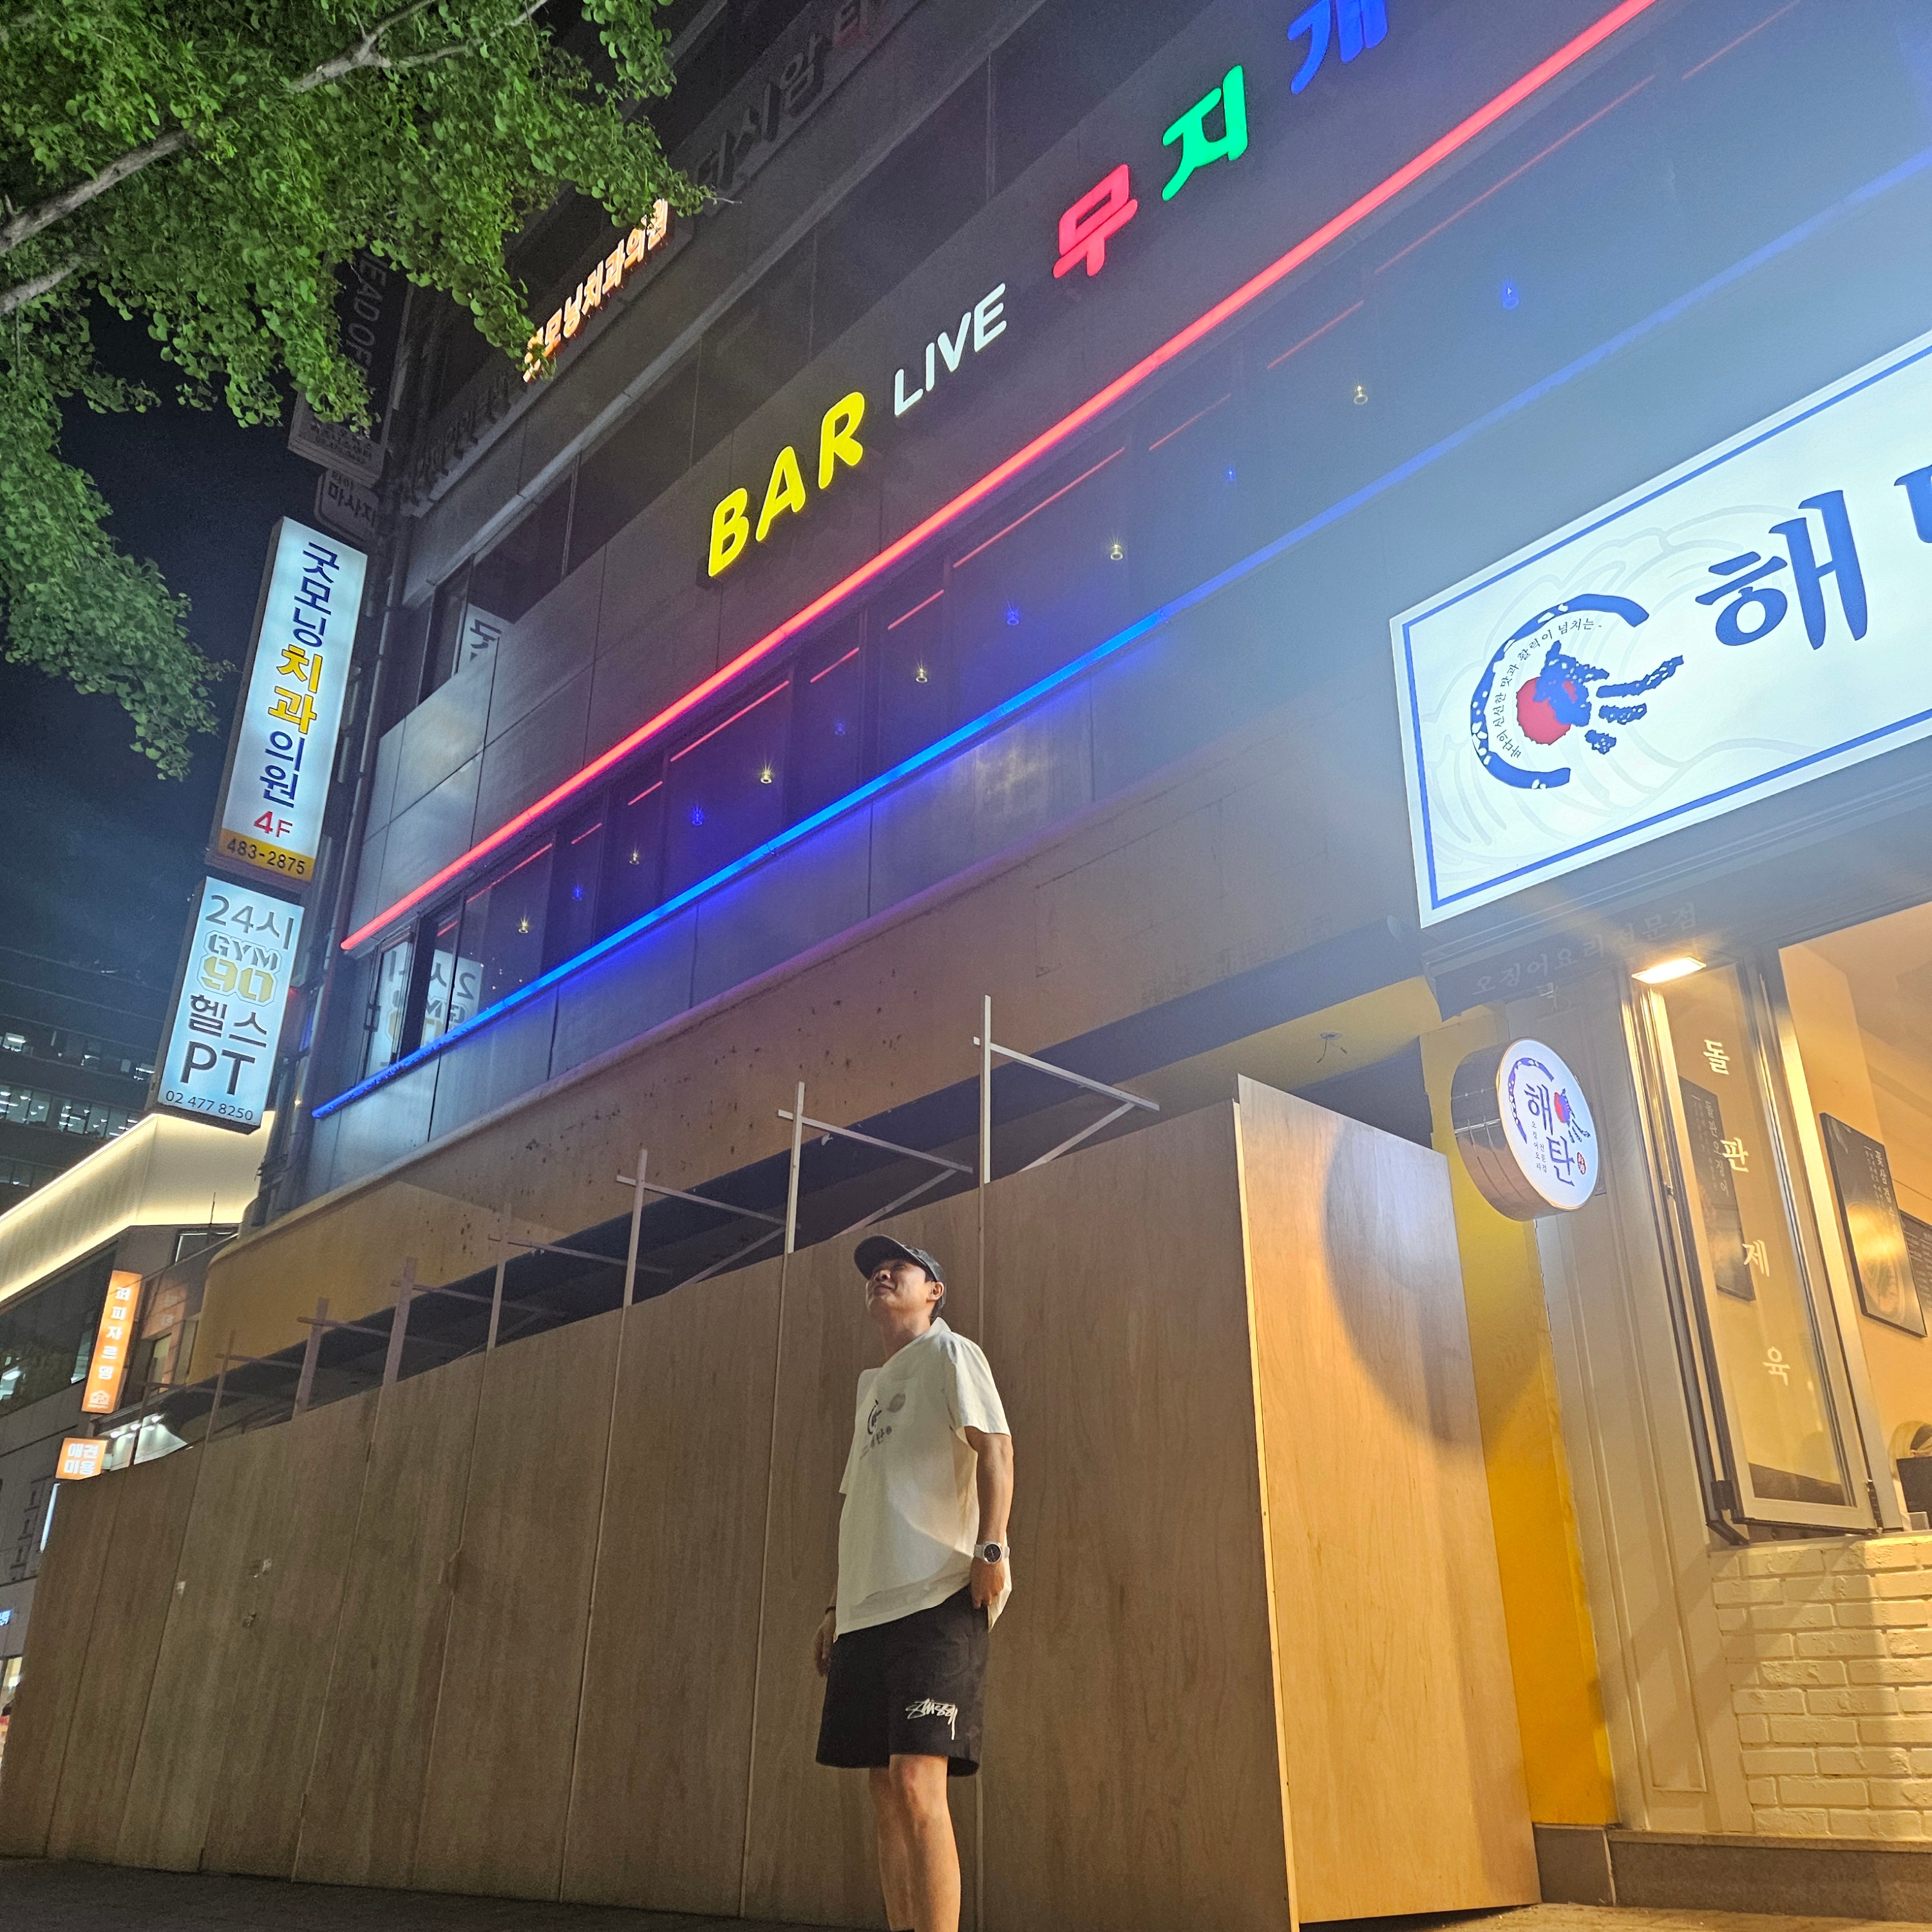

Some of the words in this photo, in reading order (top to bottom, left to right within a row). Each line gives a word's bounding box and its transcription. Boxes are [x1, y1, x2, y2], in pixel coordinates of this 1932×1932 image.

[1052, 0, 1388, 278] 무지개
[708, 391, 865, 577] BAR
[894, 283, 1007, 417] LIVE
[1517, 629, 1553, 661] 활력이
[1500, 664, 1519, 687] 맛과
[1493, 692, 1506, 727] 신선한
[1496, 729, 1522, 759] 바다의
[253, 811, 293, 838] 4F
[226, 838, 306, 875] 483-2875
[205, 895, 294, 951] 24시
[206, 934, 279, 971] GYM
[201, 956, 275, 1003] 90
[188, 994, 267, 1048] 헬스
[180, 1041, 255, 1096] PT
[166, 1090, 184, 1105] 02
[187, 1096, 215, 1111] 477
[218, 1103, 253, 1121] 8250
[1524, 1083, 1575, 1186] 해탄
[64, 1459, 95, 1475] 미용
[68, 1443, 99, 1459] 애견
